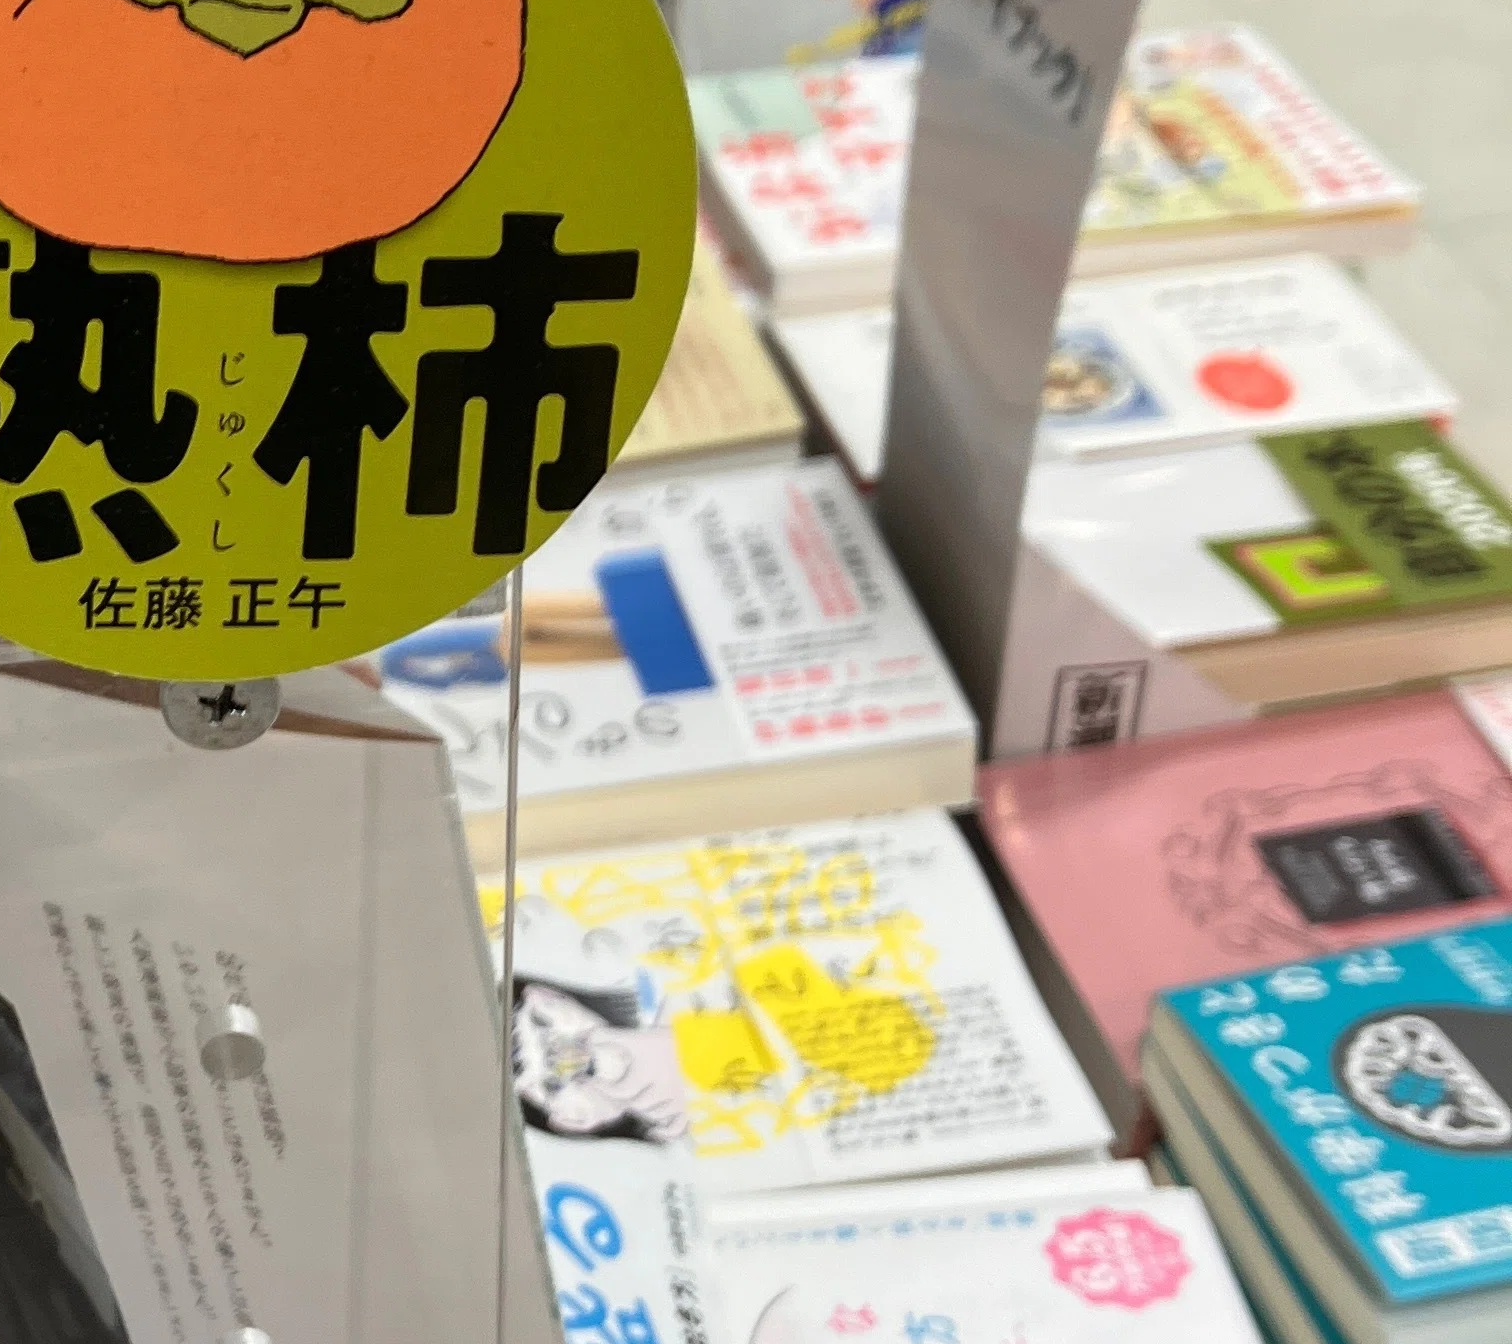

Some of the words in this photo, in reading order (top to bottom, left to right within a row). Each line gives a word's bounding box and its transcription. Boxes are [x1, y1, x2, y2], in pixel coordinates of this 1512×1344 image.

[211, 351, 246, 553] じゅくし
[77, 575, 204, 631] 佐藤
[221, 574, 347, 631] 正午
